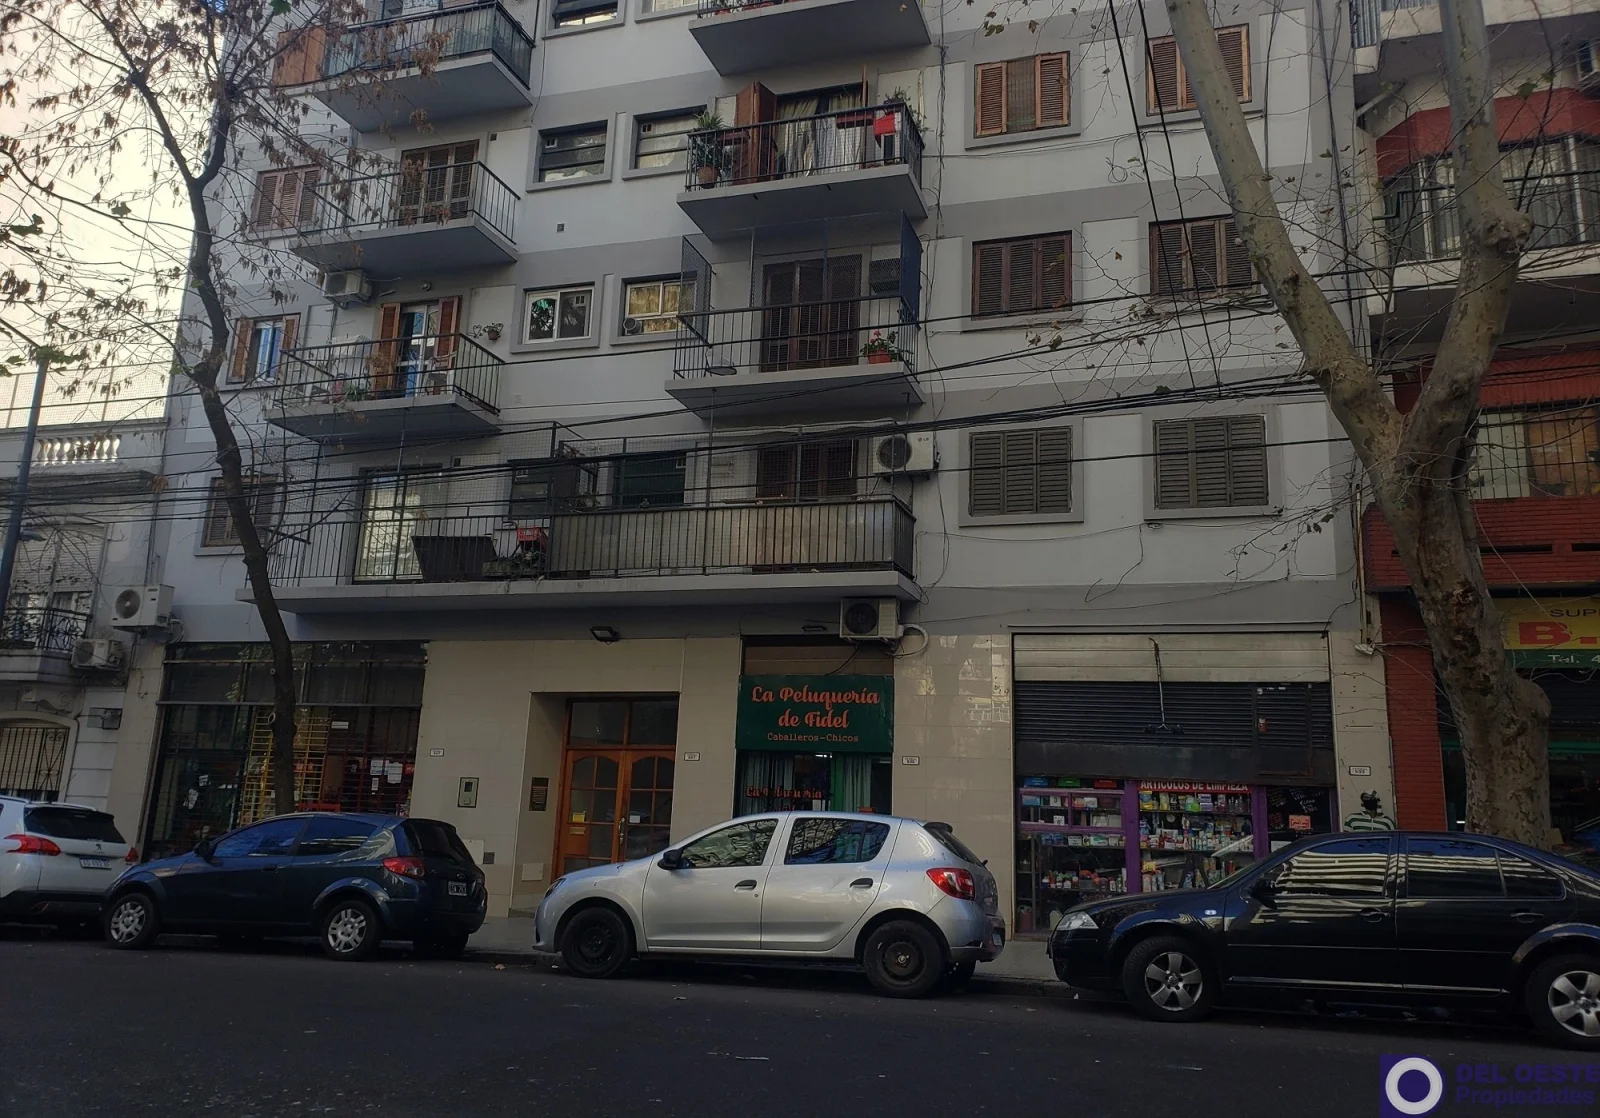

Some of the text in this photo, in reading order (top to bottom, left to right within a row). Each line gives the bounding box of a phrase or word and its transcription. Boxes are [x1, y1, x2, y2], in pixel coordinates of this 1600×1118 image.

[1550, 609, 1600, 617] SUP
[752, 684, 880, 711] La Peluquería
[778, 708, 850, 729] de Fidel
[1192, 781, 1204, 790] DE
[1206, 783, 1248, 791] LIMPIEZA
